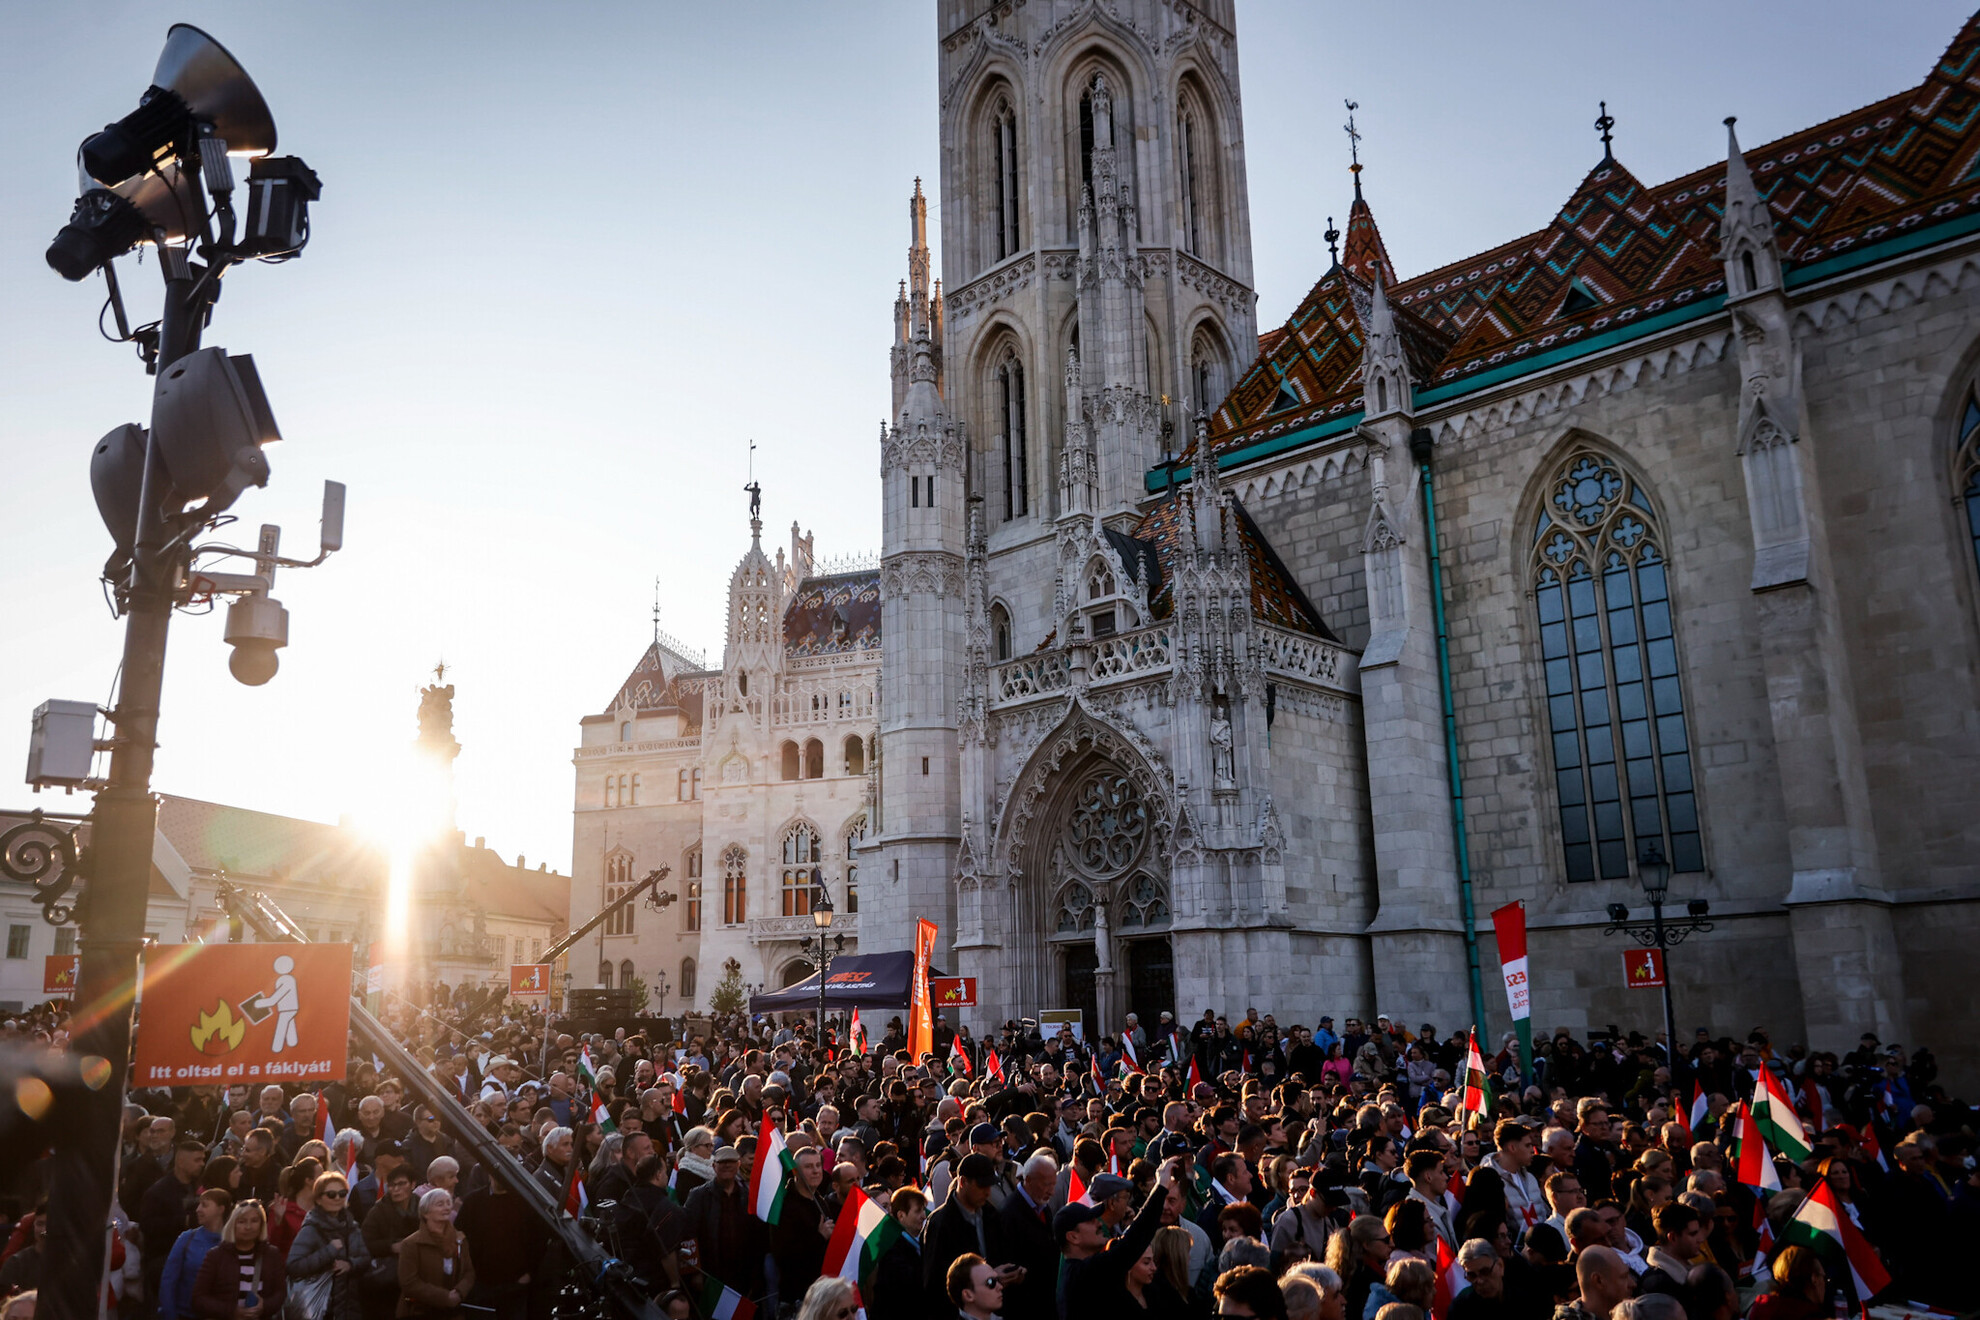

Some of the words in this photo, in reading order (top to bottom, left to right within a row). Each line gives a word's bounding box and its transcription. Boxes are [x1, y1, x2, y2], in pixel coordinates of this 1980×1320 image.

[150, 1066, 171, 1079] Itt
[177, 1064, 222, 1078] oltsd
[227, 1063, 244, 1076] el
[249, 1065, 260, 1075] a
[265, 1060, 331, 1076] fáklyát!
